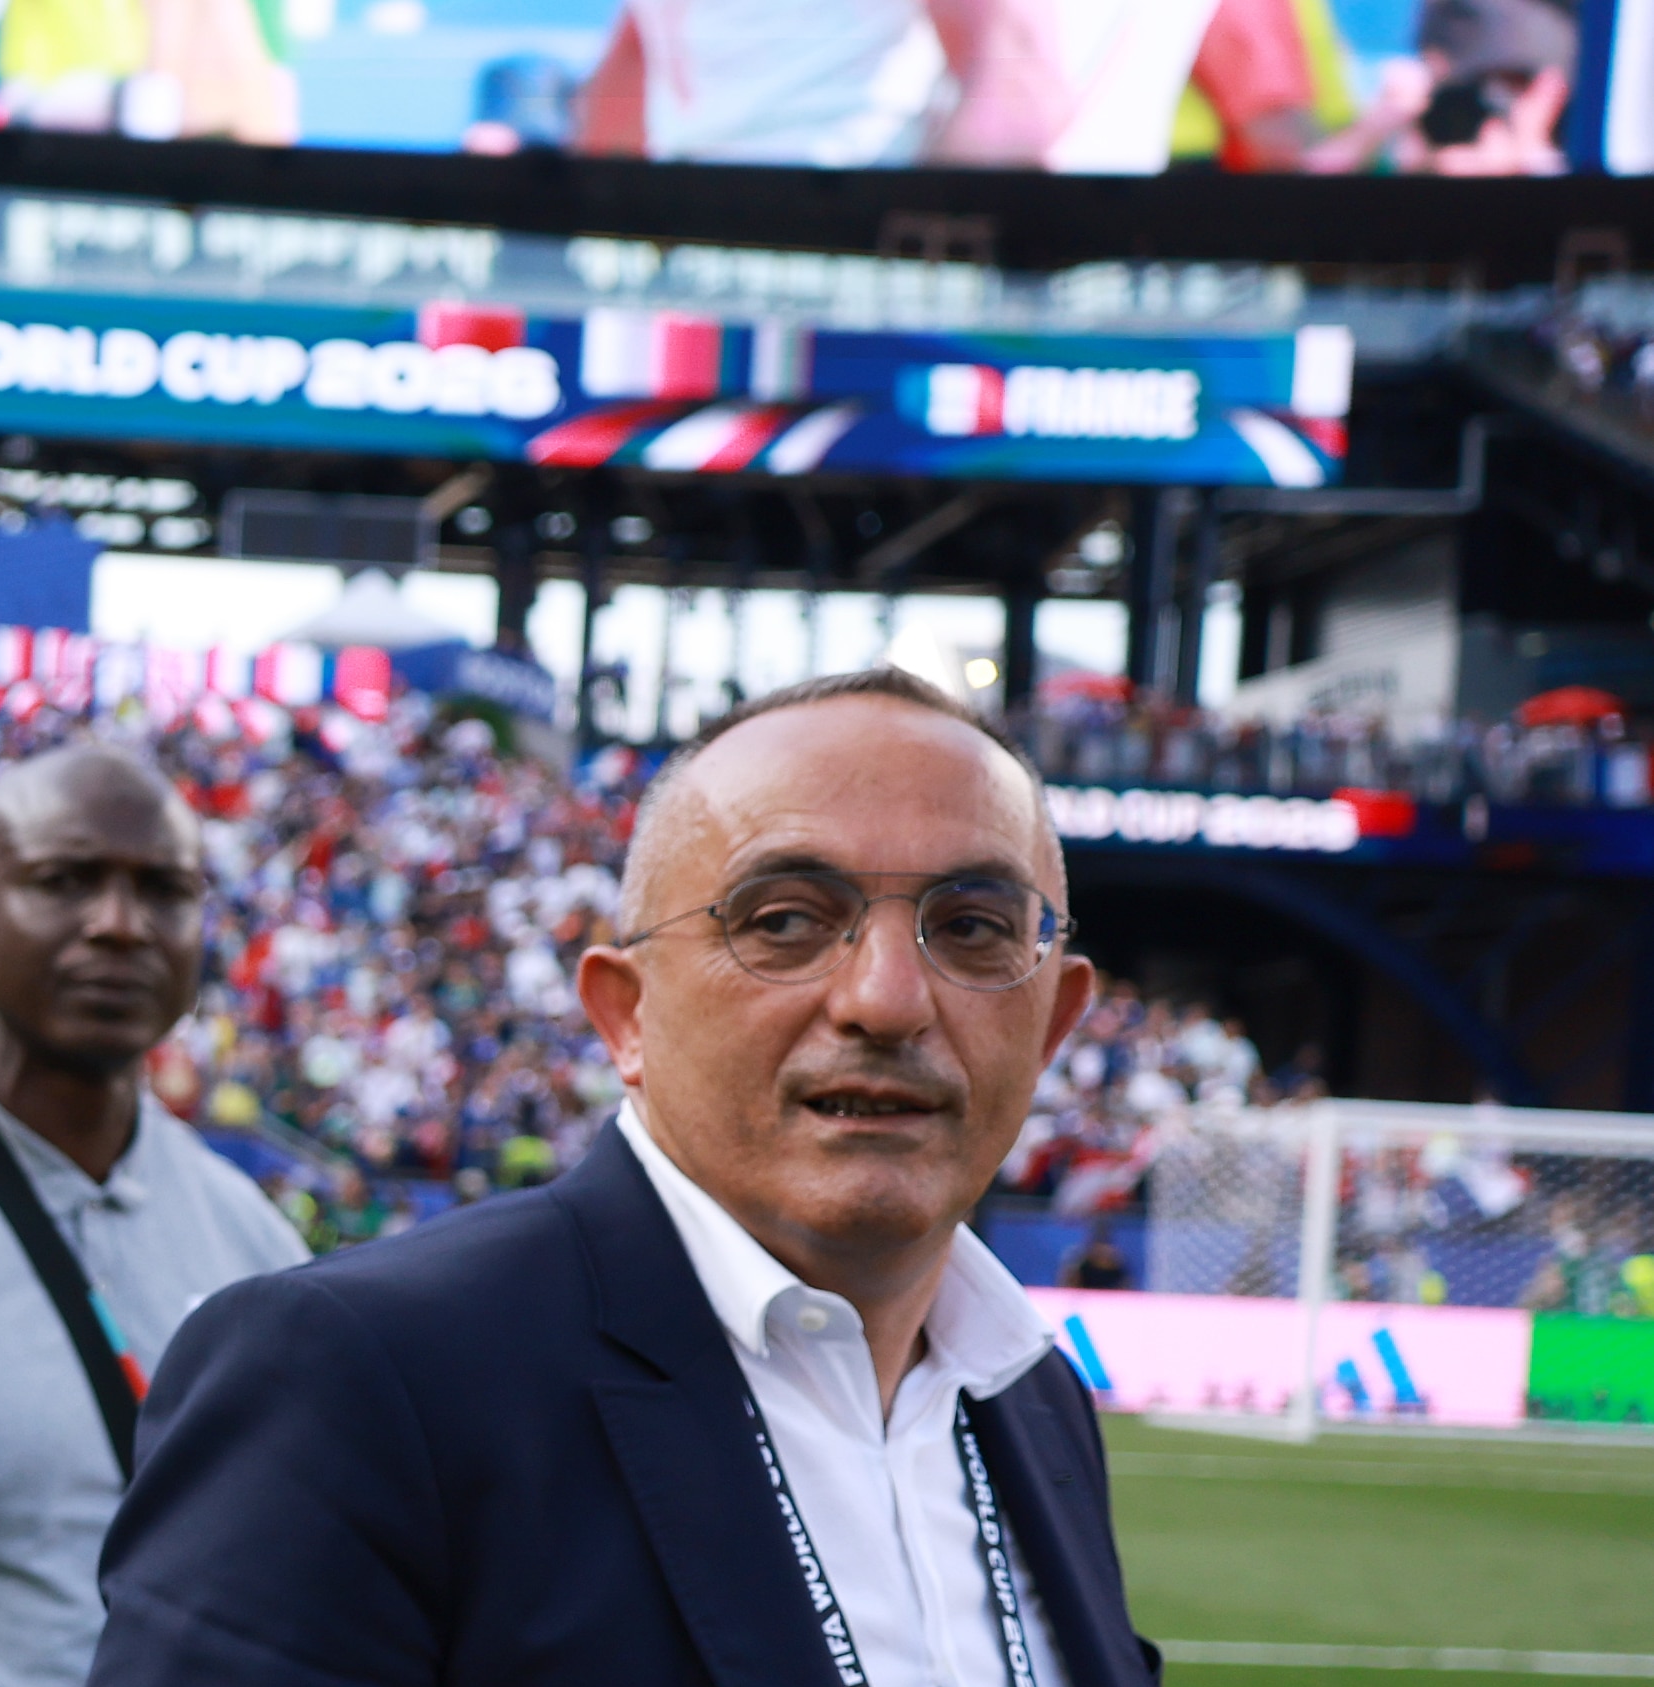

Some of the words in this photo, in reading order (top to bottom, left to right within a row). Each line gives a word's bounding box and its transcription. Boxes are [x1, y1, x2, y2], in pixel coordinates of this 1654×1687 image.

[159, 331, 309, 405] CUP
[303, 338, 560, 420] 2026
[1003, 366, 1201, 439] FRANCE
[962, 1432, 1000, 1546] WORLD
[987, 1547, 1016, 1614] CUP
[821, 1611, 864, 1687] FIFA
